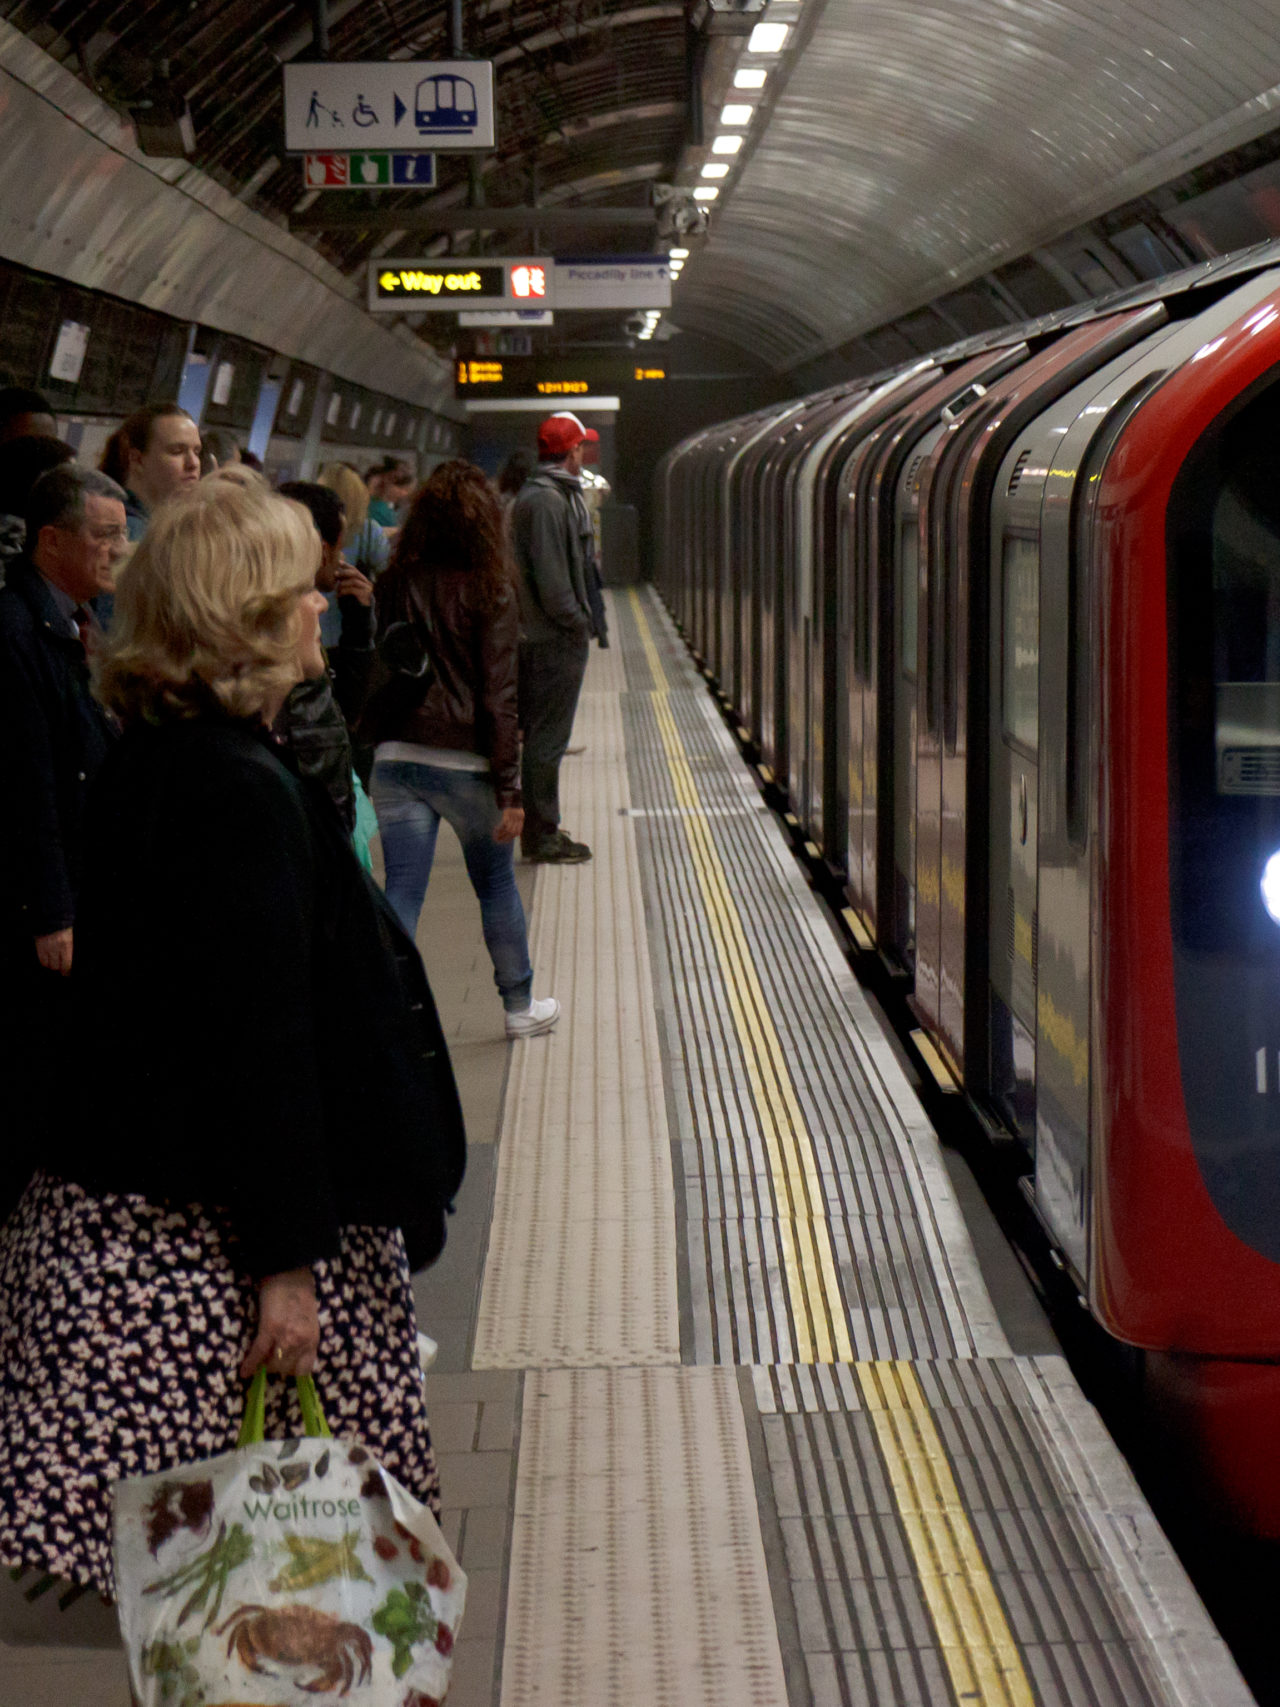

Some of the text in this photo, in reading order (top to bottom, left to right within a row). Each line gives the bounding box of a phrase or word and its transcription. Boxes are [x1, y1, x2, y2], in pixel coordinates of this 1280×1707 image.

[400, 271, 482, 294] Way out
[568, 268, 655, 282] Piccadilly line
[243, 1494, 361, 1523] Waitrose
